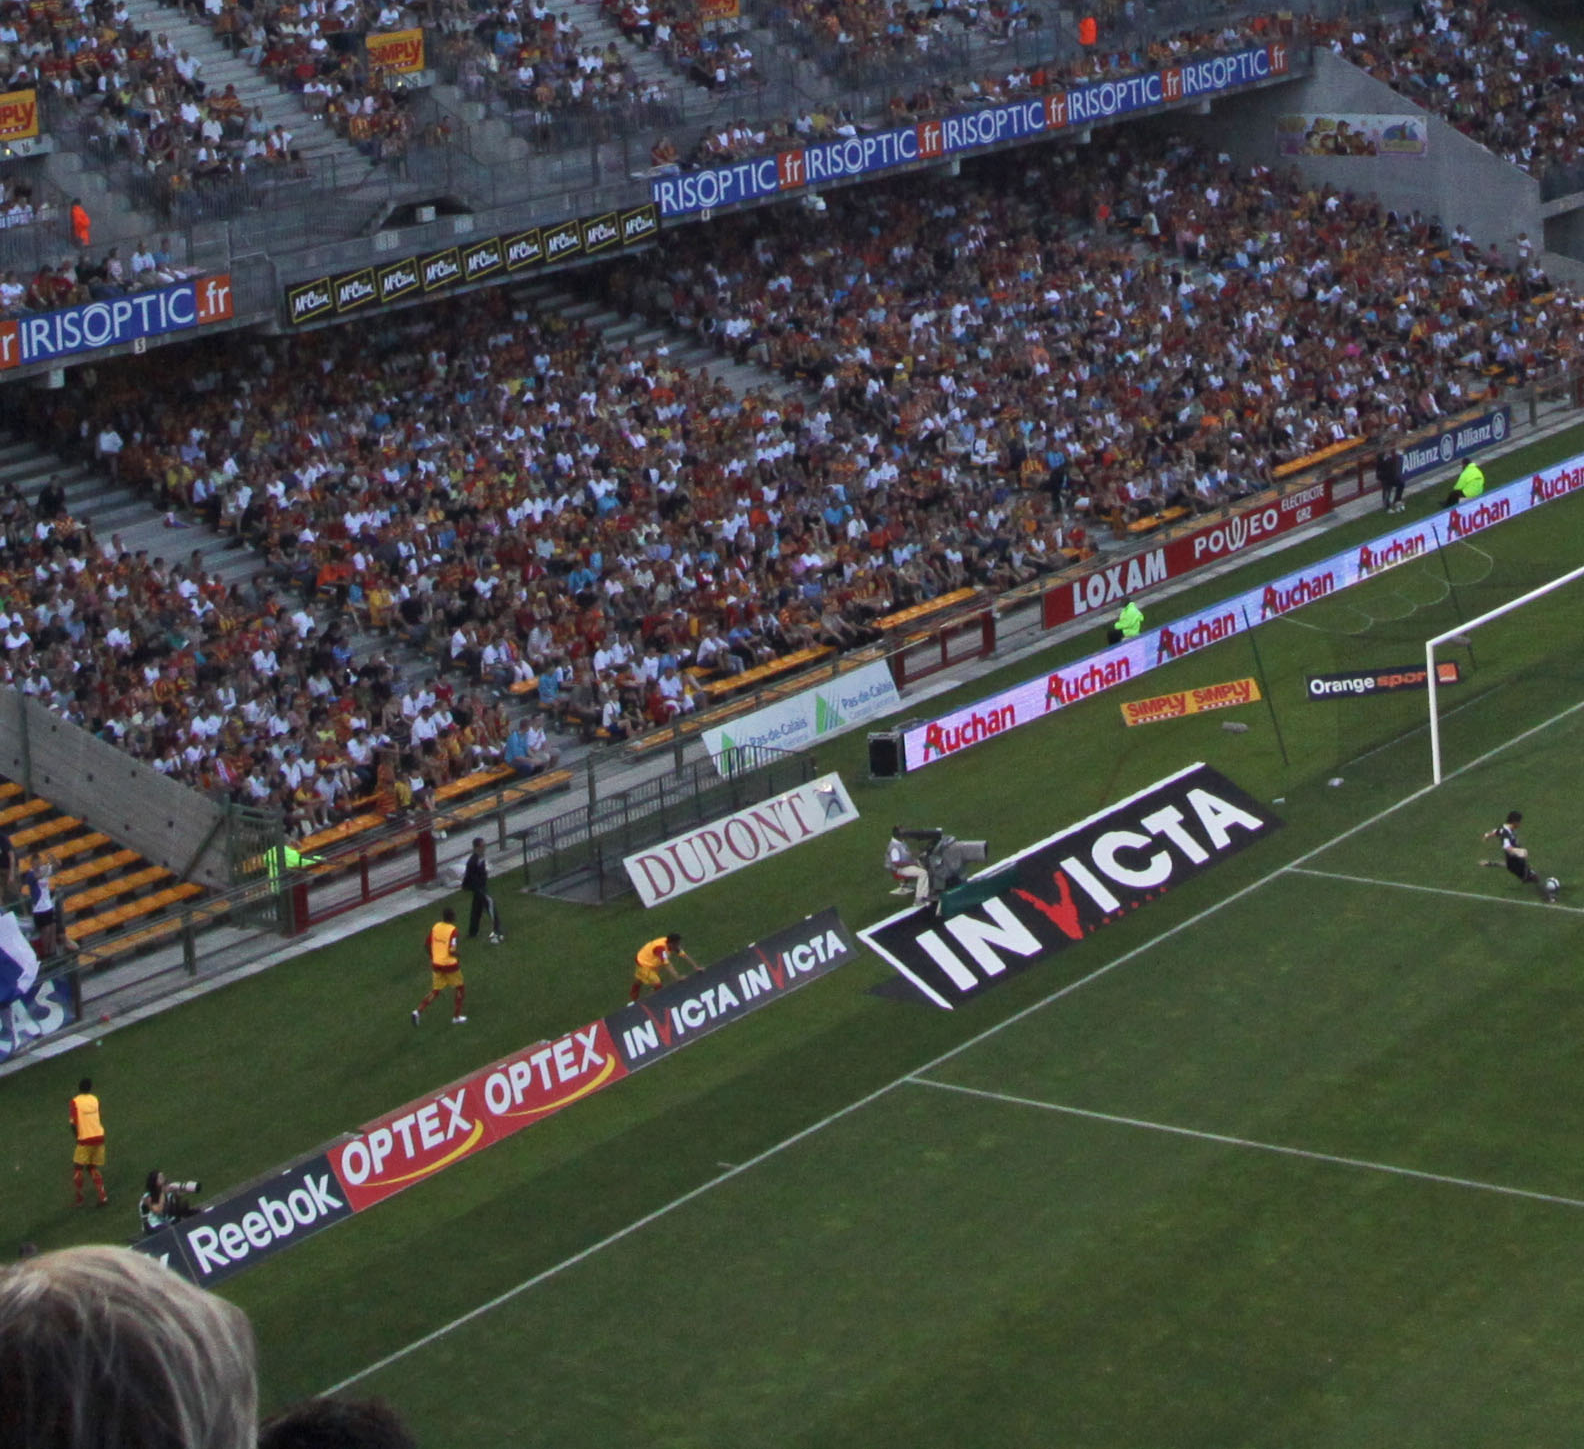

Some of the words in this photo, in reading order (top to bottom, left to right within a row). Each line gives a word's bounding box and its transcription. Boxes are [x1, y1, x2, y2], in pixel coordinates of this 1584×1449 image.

[21, 278, 230, 360] IRISOPTIC.fr
[1401, 447, 1440, 475] Allianz
[1456, 425, 1492, 451] Allianz
[1194, 508, 1278, 559] POWEO
[1447, 496, 1510, 542] Auchan
[1072, 549, 1167, 616] LOXAM
[1358, 531, 1425, 581] Auchan
[1260, 569, 1335, 620] Auchan
[1156, 612, 1236, 665] Auchan
[1046, 654, 1131, 711] Auchan
[1310, 676, 1375, 694] Orange
[1376, 670, 1428, 688] spor
[923, 701, 1015, 763] Auchan
[633, 791, 818, 902] DUPONT
[915, 787, 1264, 992] INVICTA
[623, 981, 741, 1060] INVICTA
[739, 929, 848, 1001] INVICTA
[483, 1023, 606, 1115] OPTEX
[341, 1088, 475, 1186] OPTEX
[187, 1169, 343, 1275] Reebok
